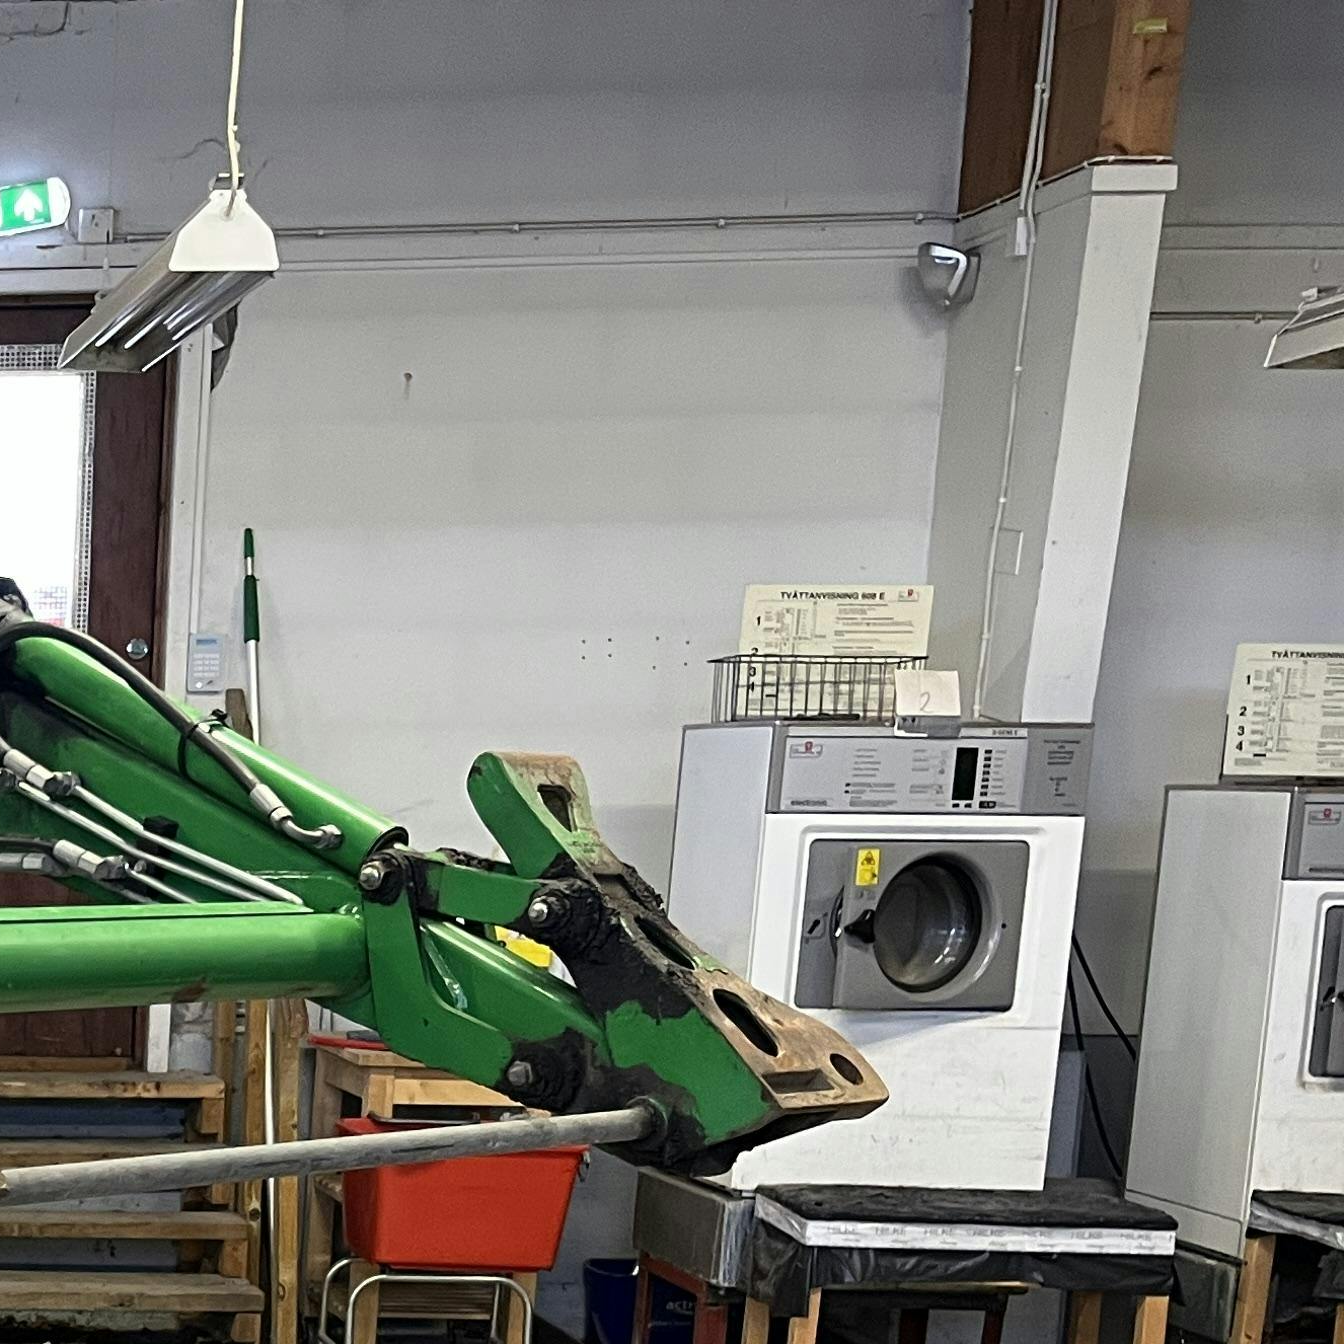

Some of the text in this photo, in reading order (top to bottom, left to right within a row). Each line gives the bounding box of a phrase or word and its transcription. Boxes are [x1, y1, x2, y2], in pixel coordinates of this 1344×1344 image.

[1246, 674, 1251, 685] 1
[919, 691, 934, 713] 2
[1239, 706, 1247, 717] 2
[1237, 726, 1245, 736] 3
[1235, 741, 1243, 751] 4
